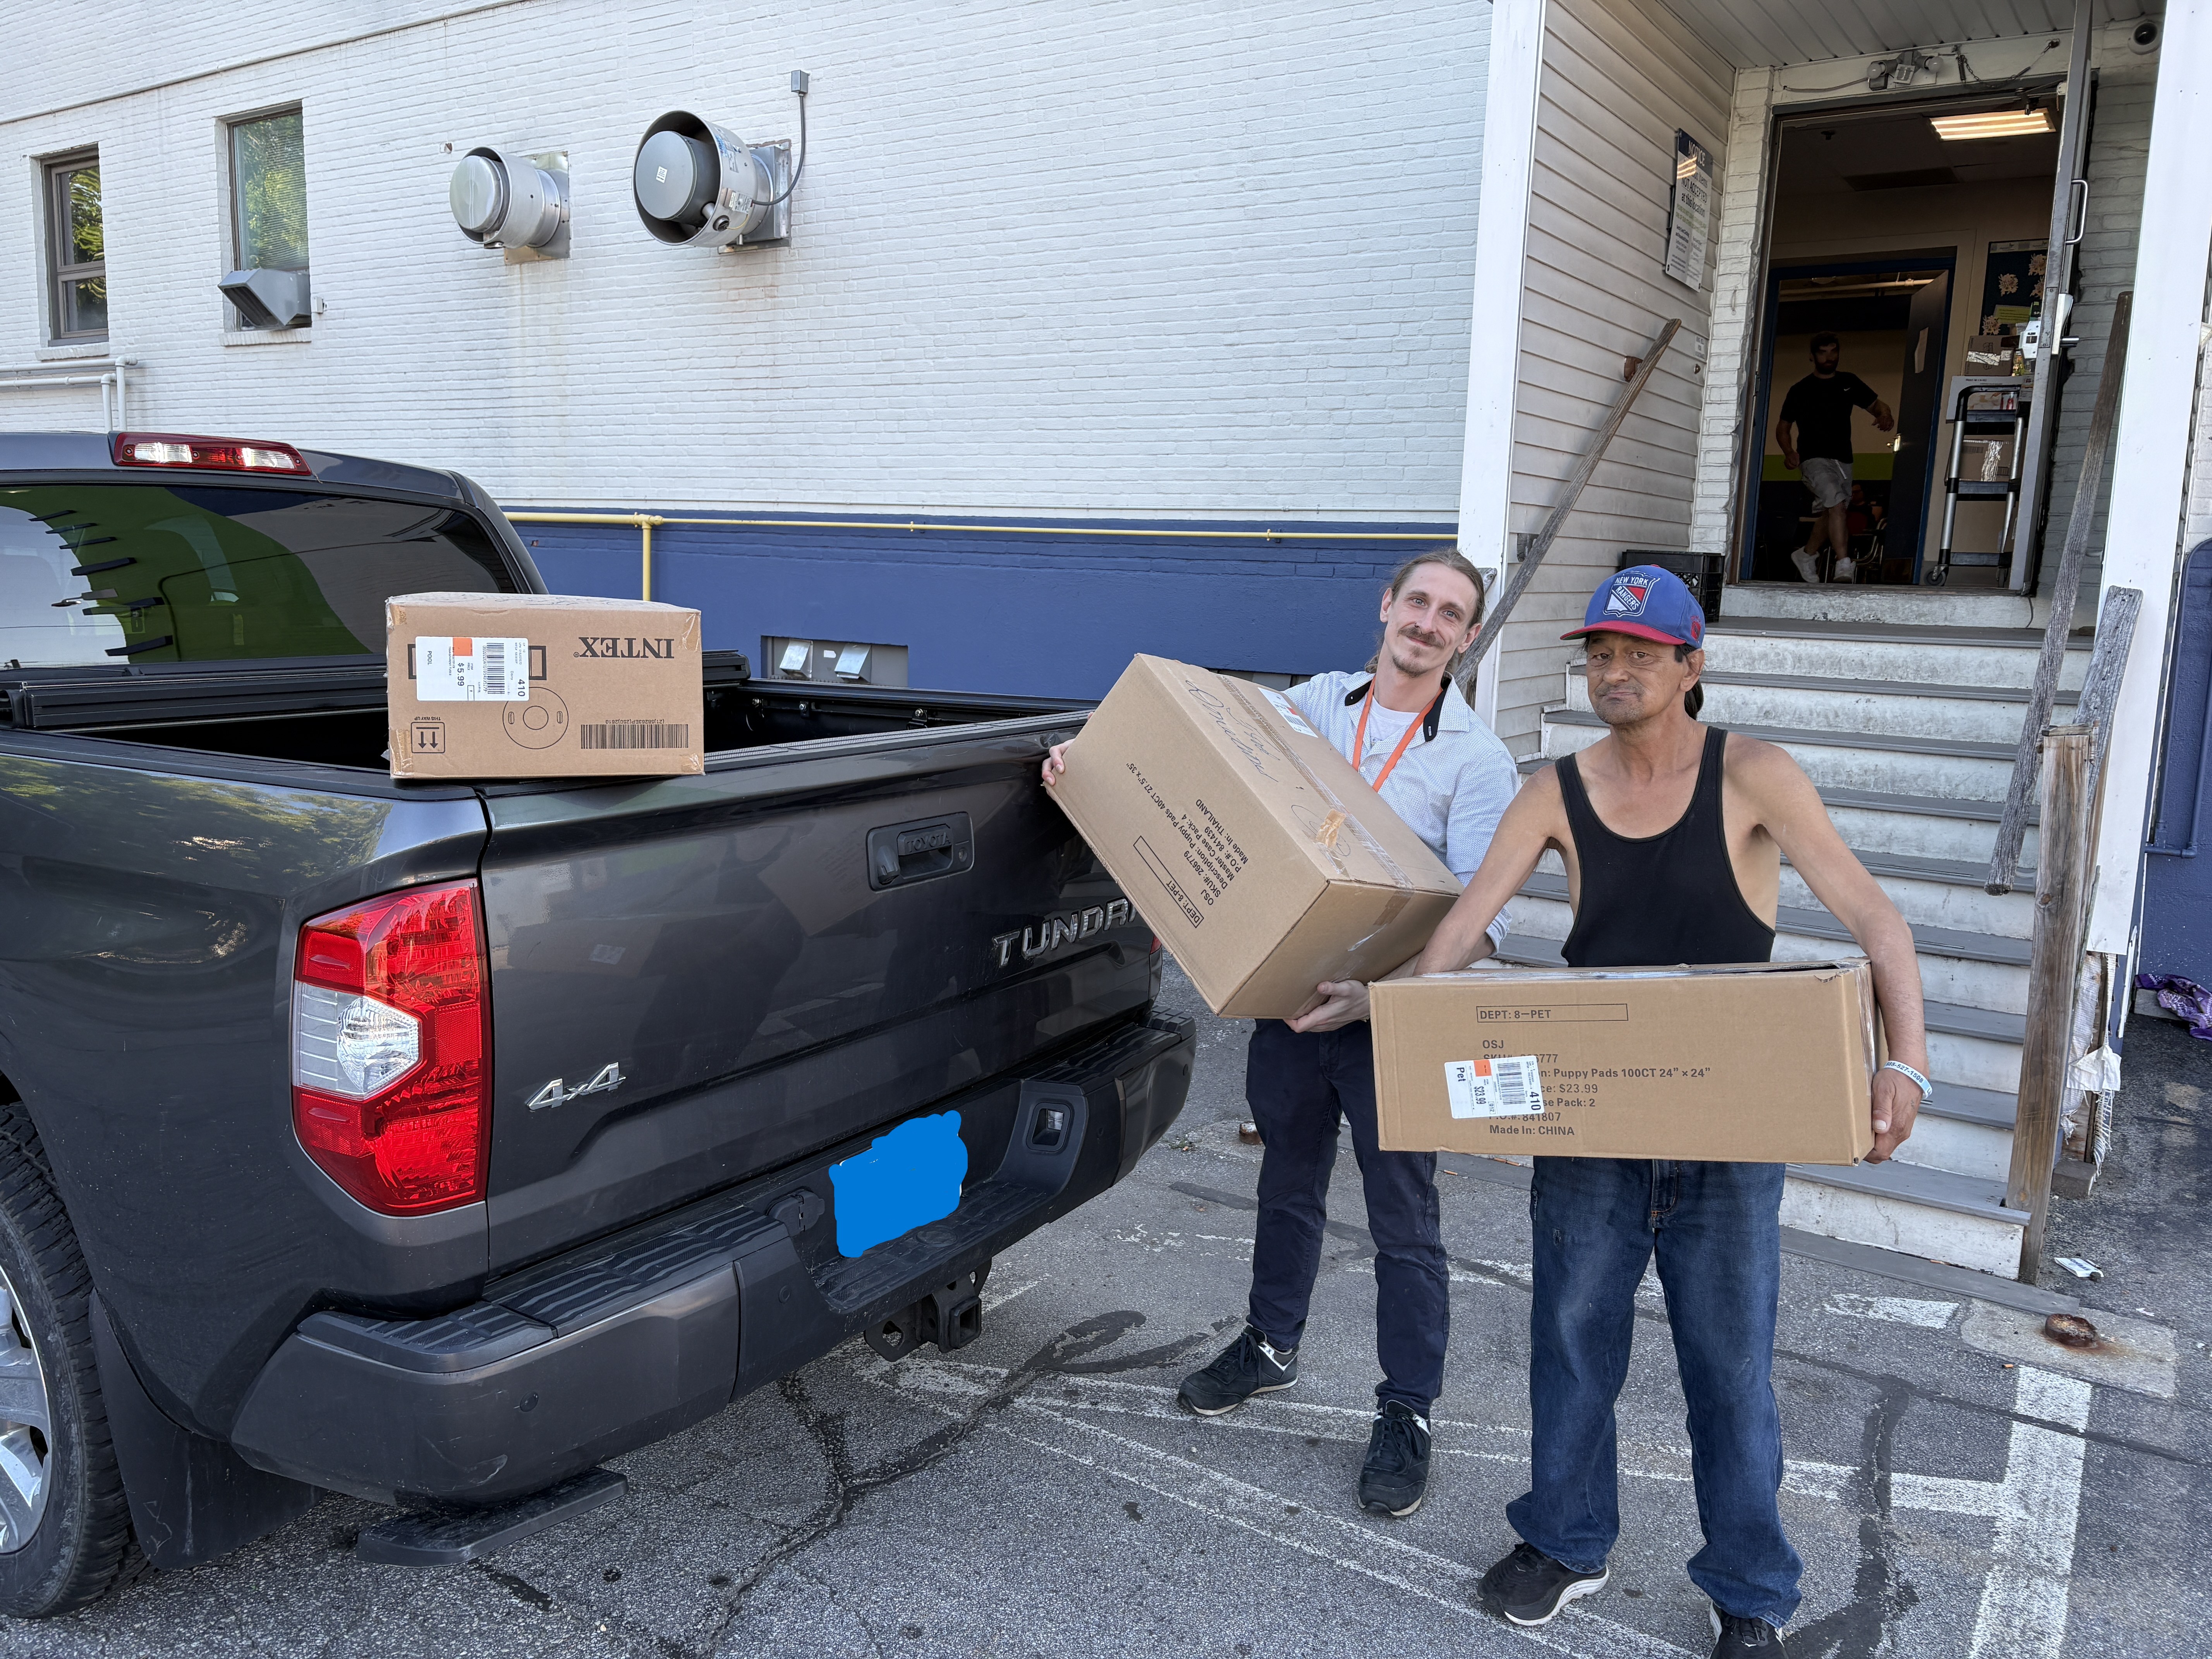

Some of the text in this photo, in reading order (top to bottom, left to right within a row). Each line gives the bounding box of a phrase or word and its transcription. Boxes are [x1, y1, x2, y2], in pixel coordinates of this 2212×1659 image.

[1688, 140, 1705, 167] NOTICE
[1690, 181, 1707, 203] ACCEPTED
[1681, 193, 1686, 203] at
[1692, 197, 1705, 217] location
[1631, 576, 1648, 586] YORK
[1615, 586, 1640, 610] RANGERS
[1151, 793, 1165, 809] 40CT
[1166, 809, 1179, 827] Pads
[1178, 826, 1196, 848] Puppy
[1187, 819, 1202, 840] Pack:
[1196, 799, 1248, 864] Made In: THAILAND
[906, 832, 951, 853] TOYOTA
[1202, 838, 1215, 857] Case
[1205, 826, 1241, 872] P.O.#: 841439
[1184, 851, 1220, 897] SKU#: 266779
[1195, 847, 1228, 889] Description:
[1215, 856, 1235, 881] Master
[1166, 881, 1200, 923] DEPT: 8-PET
[1201, 890, 1213, 905] OSJ
[992, 897, 1138, 968] TUNDR
[1480, 1010, 1511, 1019] DEPT:
[1482, 1039, 1504, 1049] OSJ
[1456, 1067, 1466, 1082] Pet
[1554, 1068, 1588, 1079] Puppy
[1592, 1068, 1618, 1077] Pads
[1621, 1068, 1657, 1077] 100CT
[525, 1061, 626, 1111] 4x4
[1474, 1086, 1486, 1104] $23.99
[1559, 1084, 1598, 1093] $23.99
[1529, 1091, 1541, 1110] 410
[1557, 1098, 1587, 1107] Pack:
[1589, 1099, 1595, 1107] 2
[1522, 1112, 1561, 1121] 841807
[1490, 1125, 1575, 1135] Made In: CHINA
